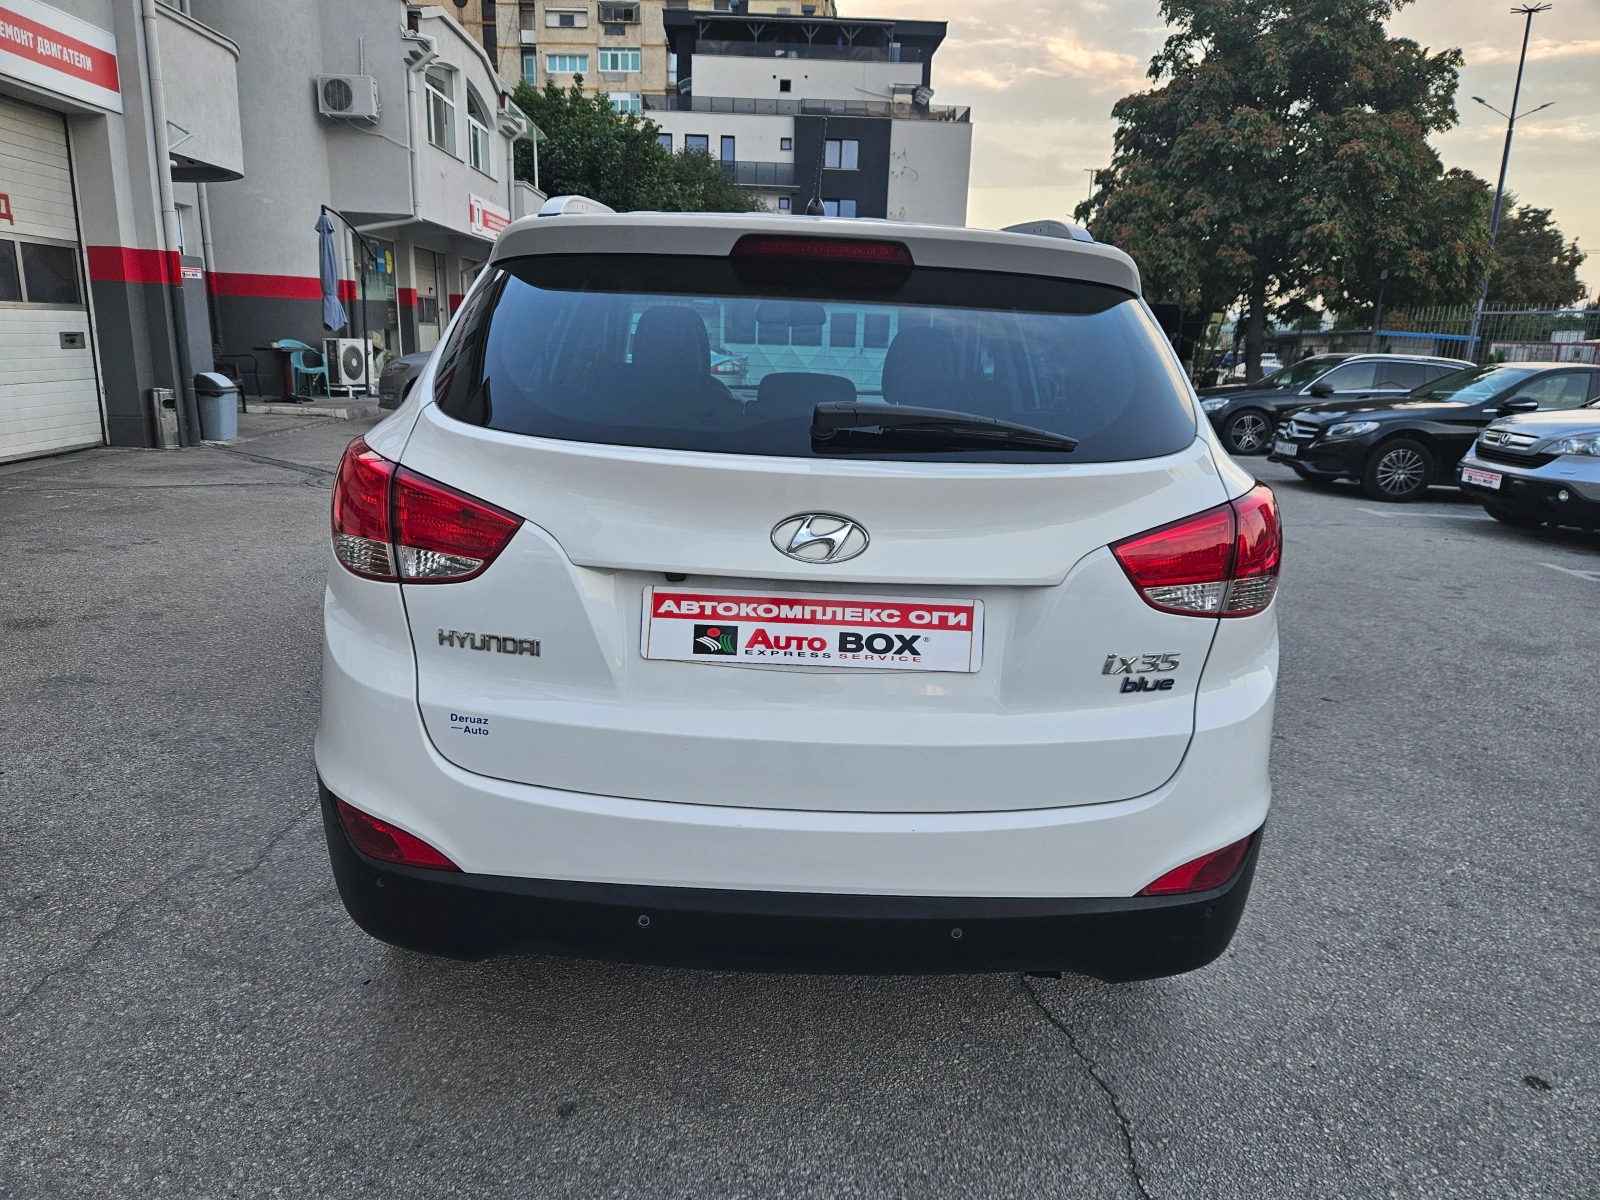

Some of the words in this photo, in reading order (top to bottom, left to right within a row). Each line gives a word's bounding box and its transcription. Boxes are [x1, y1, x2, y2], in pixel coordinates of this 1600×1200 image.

[37, 36, 93, 72] ДВИГАТЕЛИ
[657, 599, 901, 623] АВТОКОМПЛЕКС
[908, 610, 968, 626] ОГИ
[438, 628, 541, 657] HYUNDAI
[745, 649, 831, 659] EXPRESS
[838, 653, 922, 663] SERVICE
[1101, 651, 1182, 675] ix35
[1119, 676, 1175, 694] blue
[450, 713, 489, 725] Deruaz
